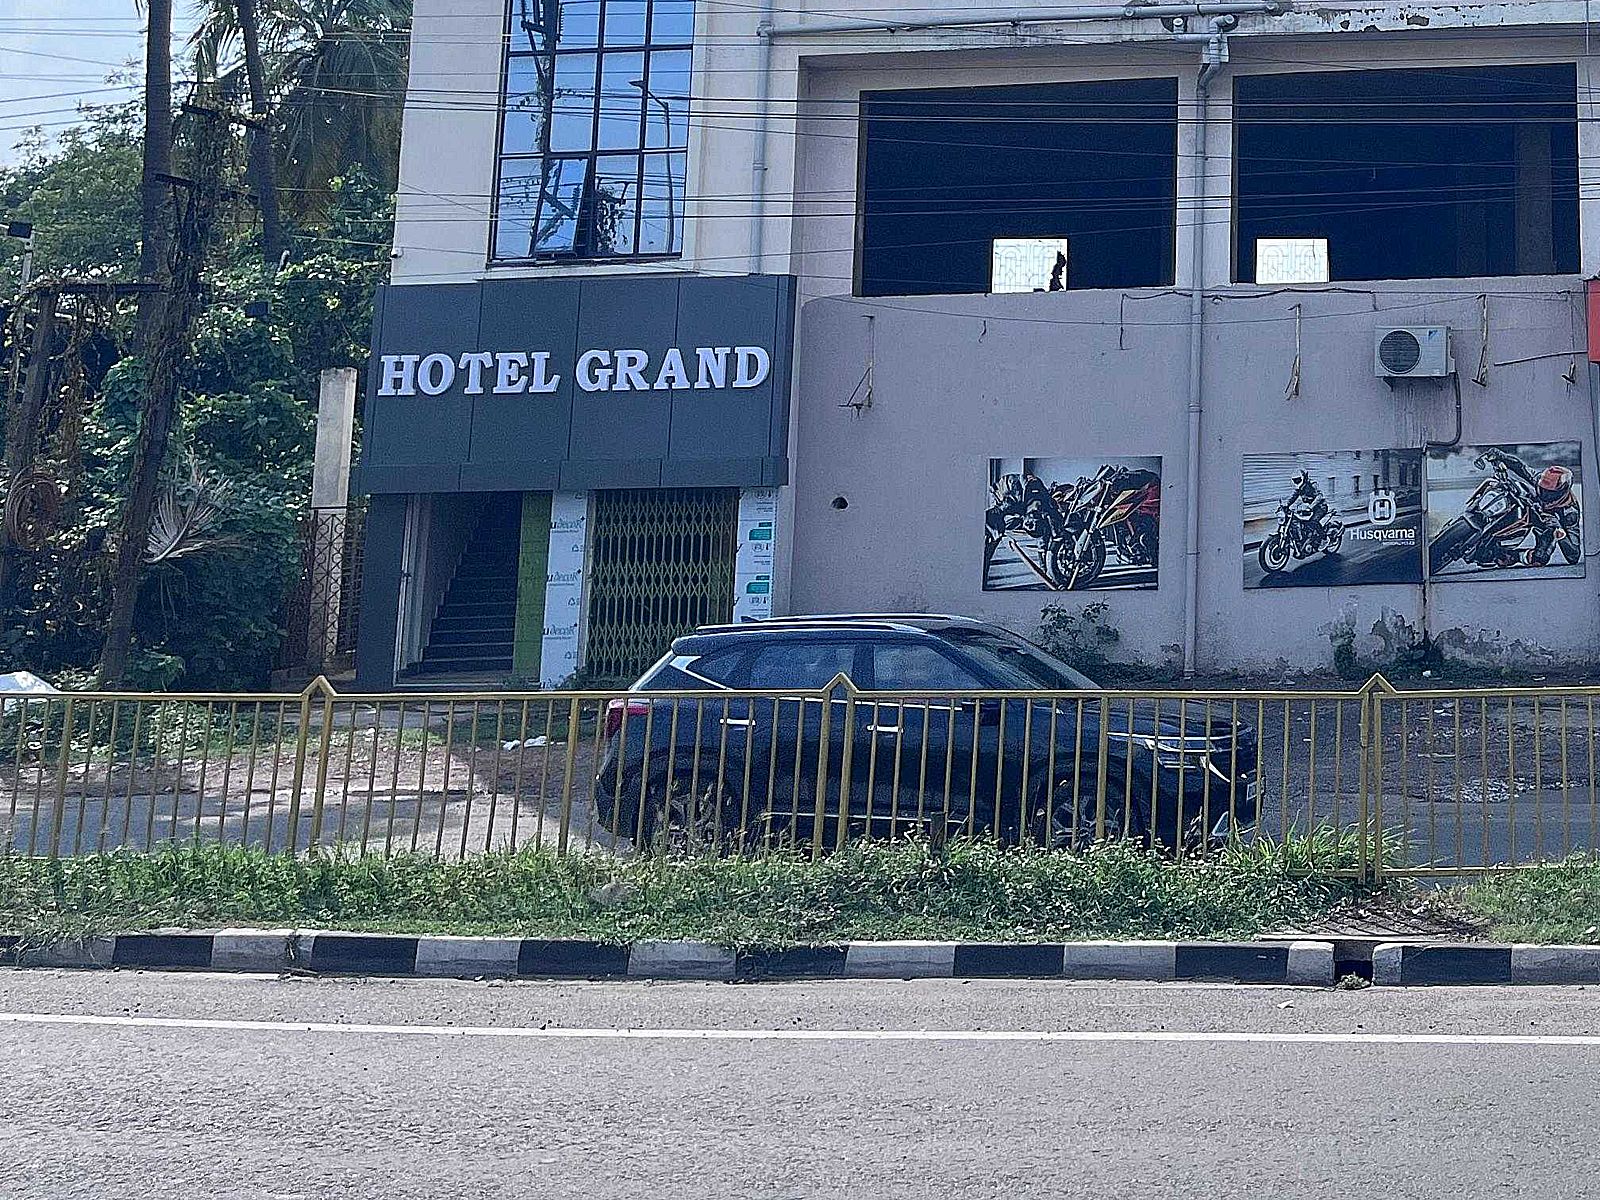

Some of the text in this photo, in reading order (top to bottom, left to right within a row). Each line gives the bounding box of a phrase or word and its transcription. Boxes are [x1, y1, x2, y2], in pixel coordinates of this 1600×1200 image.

[377, 346, 770, 397] HOTEL GRAND
[1350, 528, 1415, 541] Husqvarna
